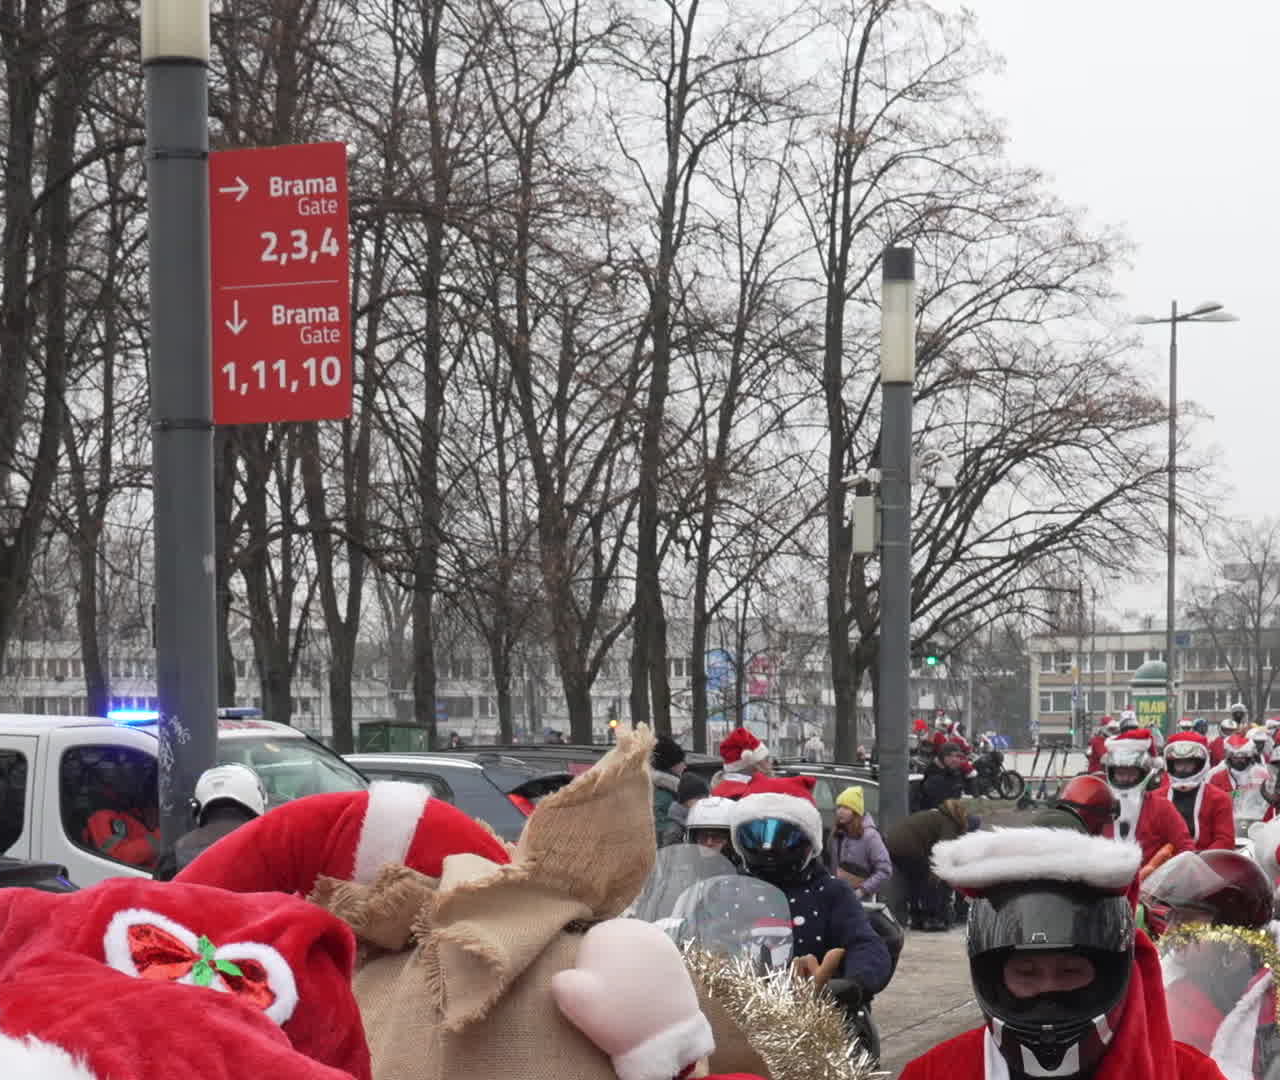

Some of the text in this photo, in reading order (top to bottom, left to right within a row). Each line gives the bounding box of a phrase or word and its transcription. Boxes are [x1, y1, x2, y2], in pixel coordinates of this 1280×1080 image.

[269, 175, 338, 197] Brama
[298, 197, 338, 216] Gate
[260, 227, 340, 266] 2,3,4
[271, 304, 341, 326] Brama
[300, 325, 341, 345] Gate
[222, 355, 342, 396] 1,11,10
